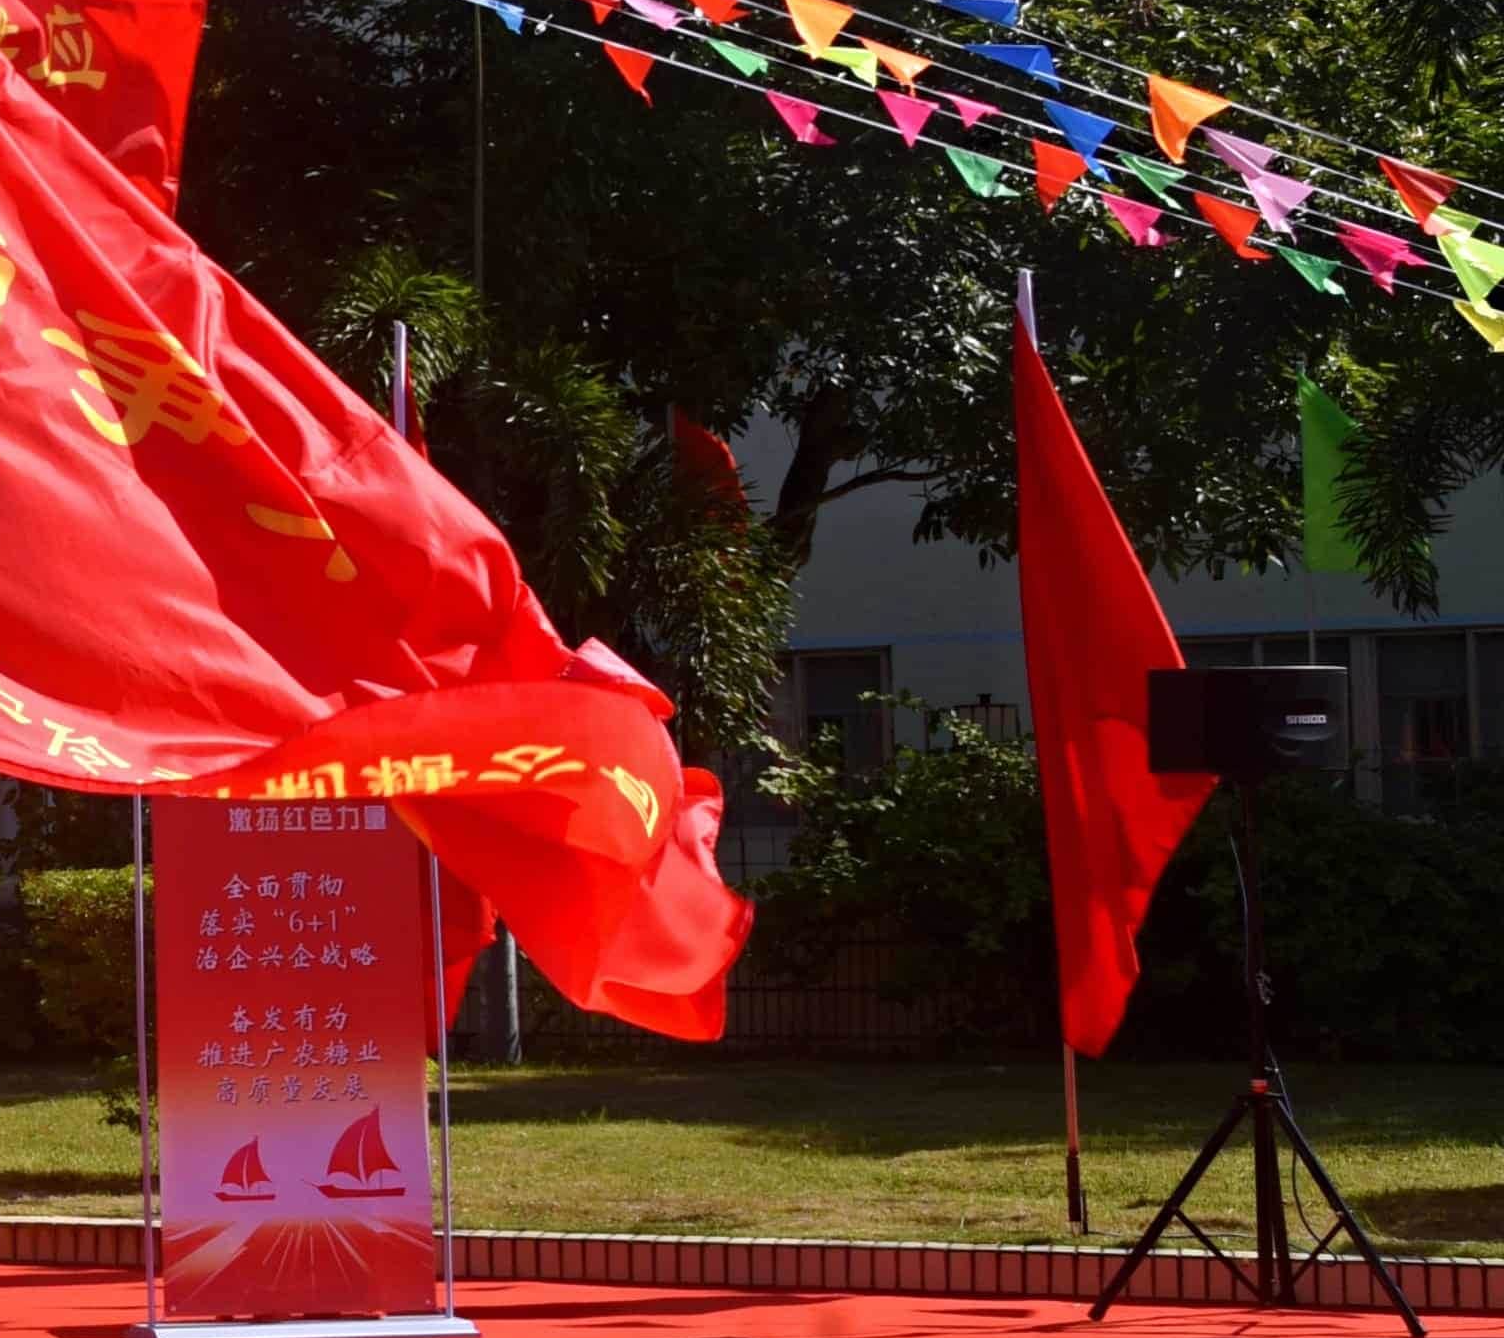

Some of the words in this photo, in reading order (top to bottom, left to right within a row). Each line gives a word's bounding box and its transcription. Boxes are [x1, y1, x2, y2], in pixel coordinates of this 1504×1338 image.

[228, 805, 386, 832] 激扬红色力量
[222, 871, 345, 900] 全面贯彻
[195, 941, 379, 971] 治企兴企战略
[228, 1002, 350, 1034] 奋发有为
[198, 1038, 383, 1069] 推进广农糖业
[216, 1072, 369, 1105] 高质量发展
